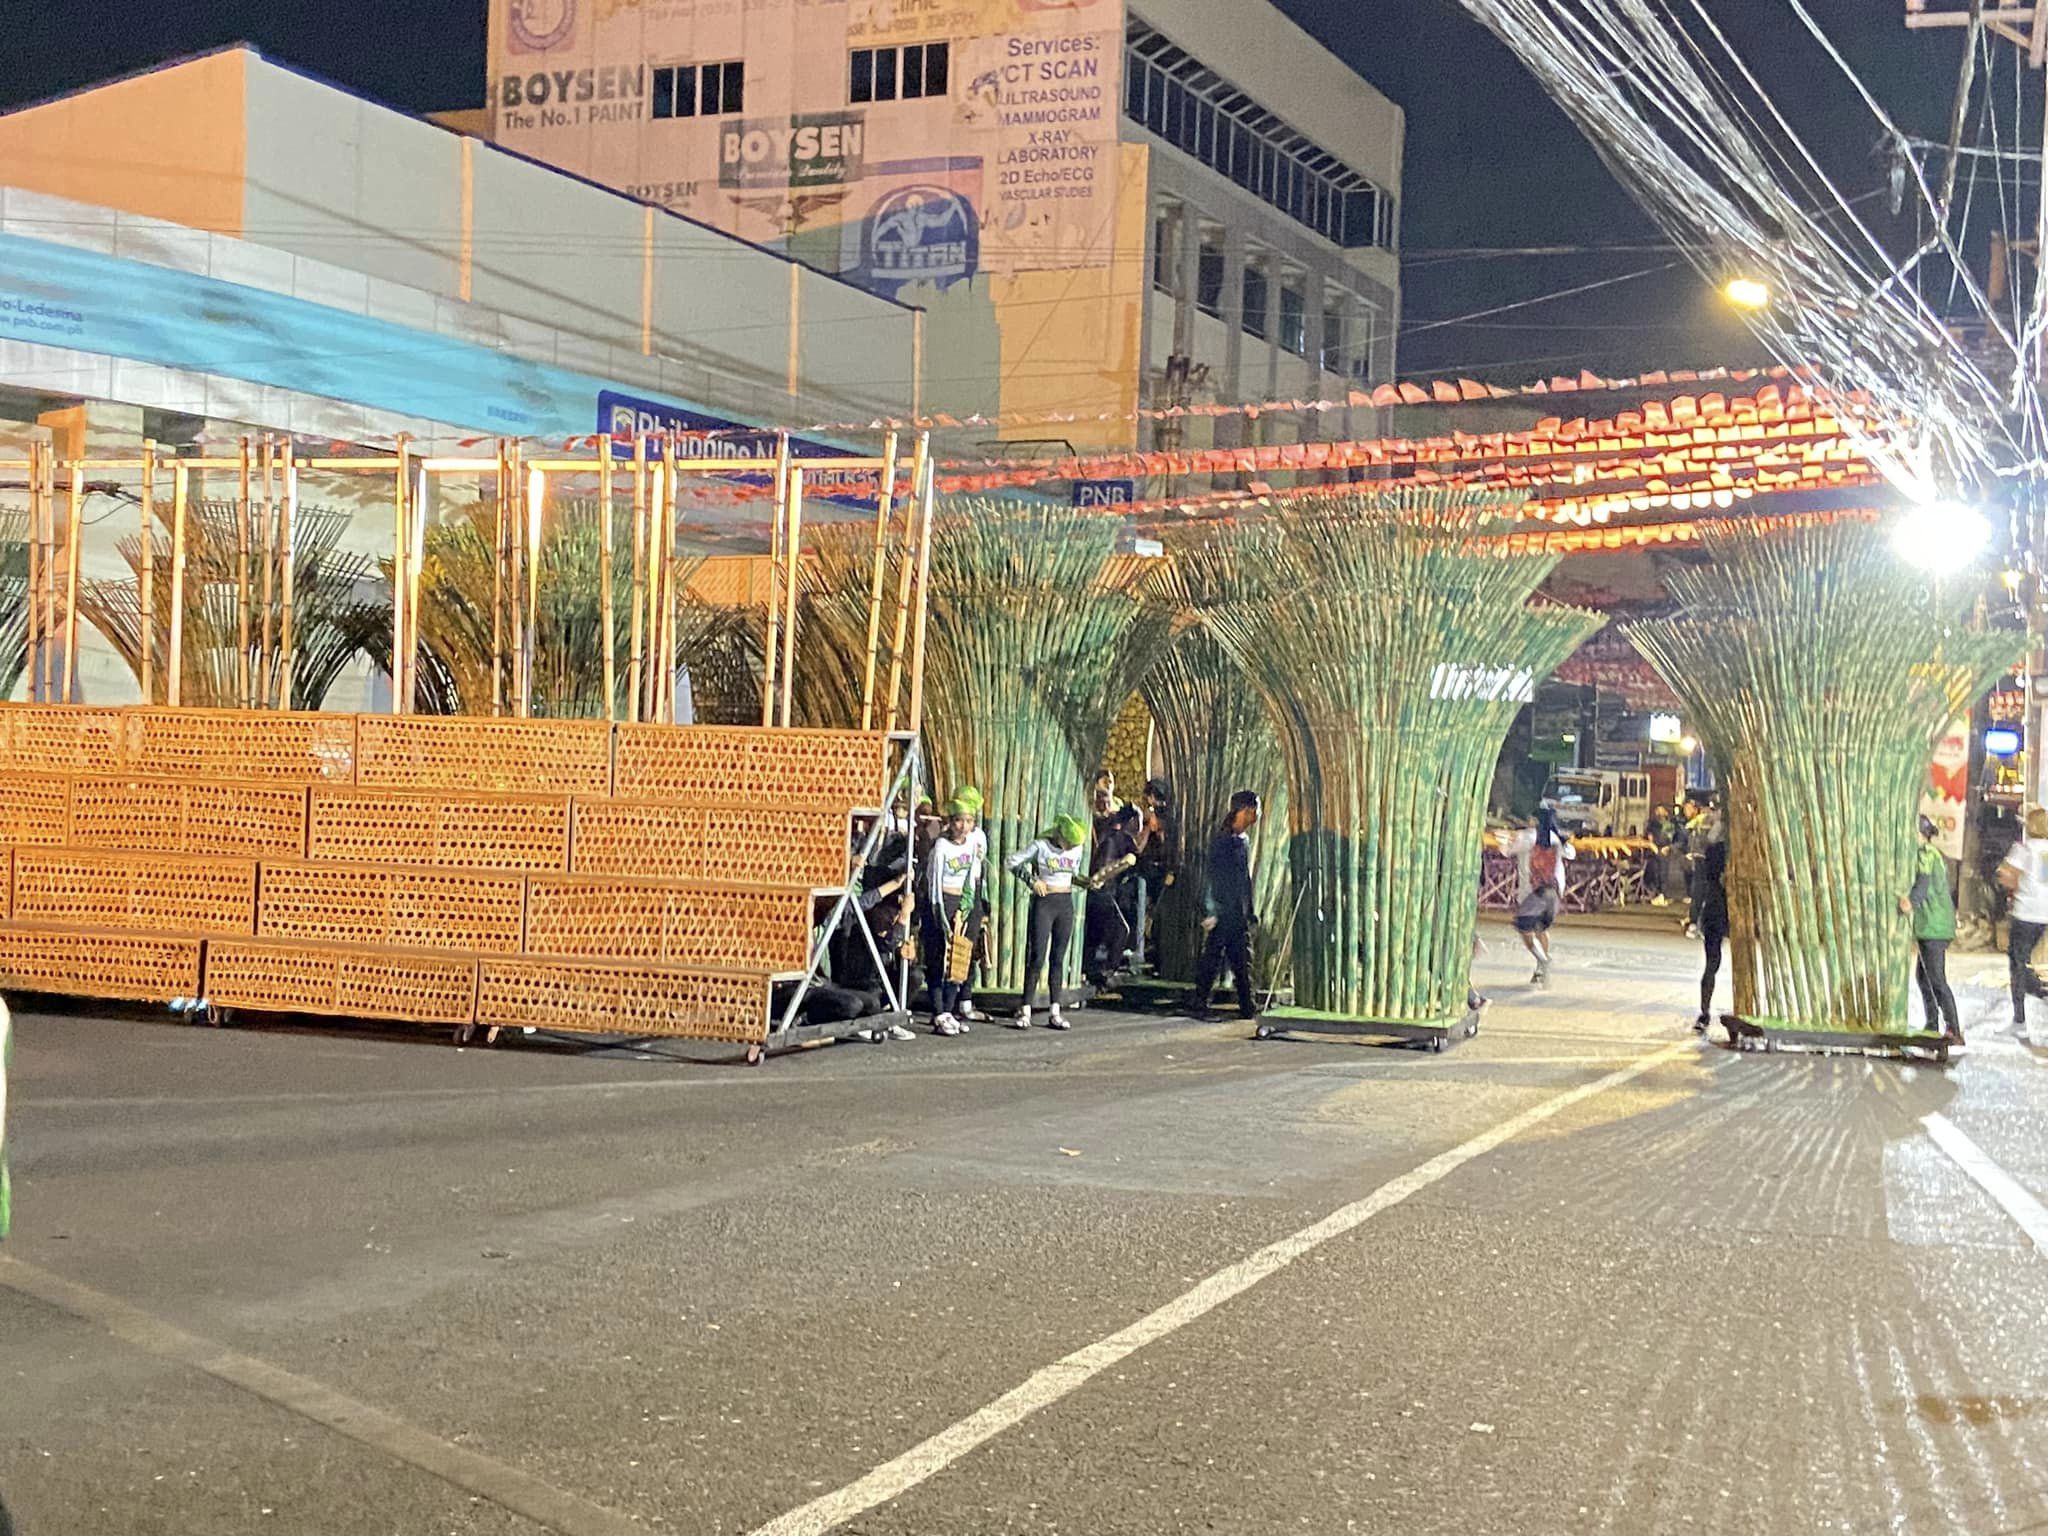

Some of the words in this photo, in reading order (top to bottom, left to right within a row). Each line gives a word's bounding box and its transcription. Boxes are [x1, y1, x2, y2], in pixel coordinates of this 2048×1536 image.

[1008, 37, 1100, 57] Services:
[1040, 59, 1098, 80] SCAN
[502, 63, 644, 107] BOYSEN
[997, 86, 1101, 105] ULTRASOUND
[504, 111, 534, 129] The
[589, 101, 643, 123] PAINT
[1000, 107, 1100, 125] MAMMOGRAM
[724, 124, 861, 163] BOYSEN
[1028, 129, 1071, 144] X-RAY
[997, 146, 1098, 164] LABORATORY
[1000, 171, 1020, 184] 2D
[625, 181, 698, 198] BOYSEN
[1080, 485, 1126, 506] PNB
